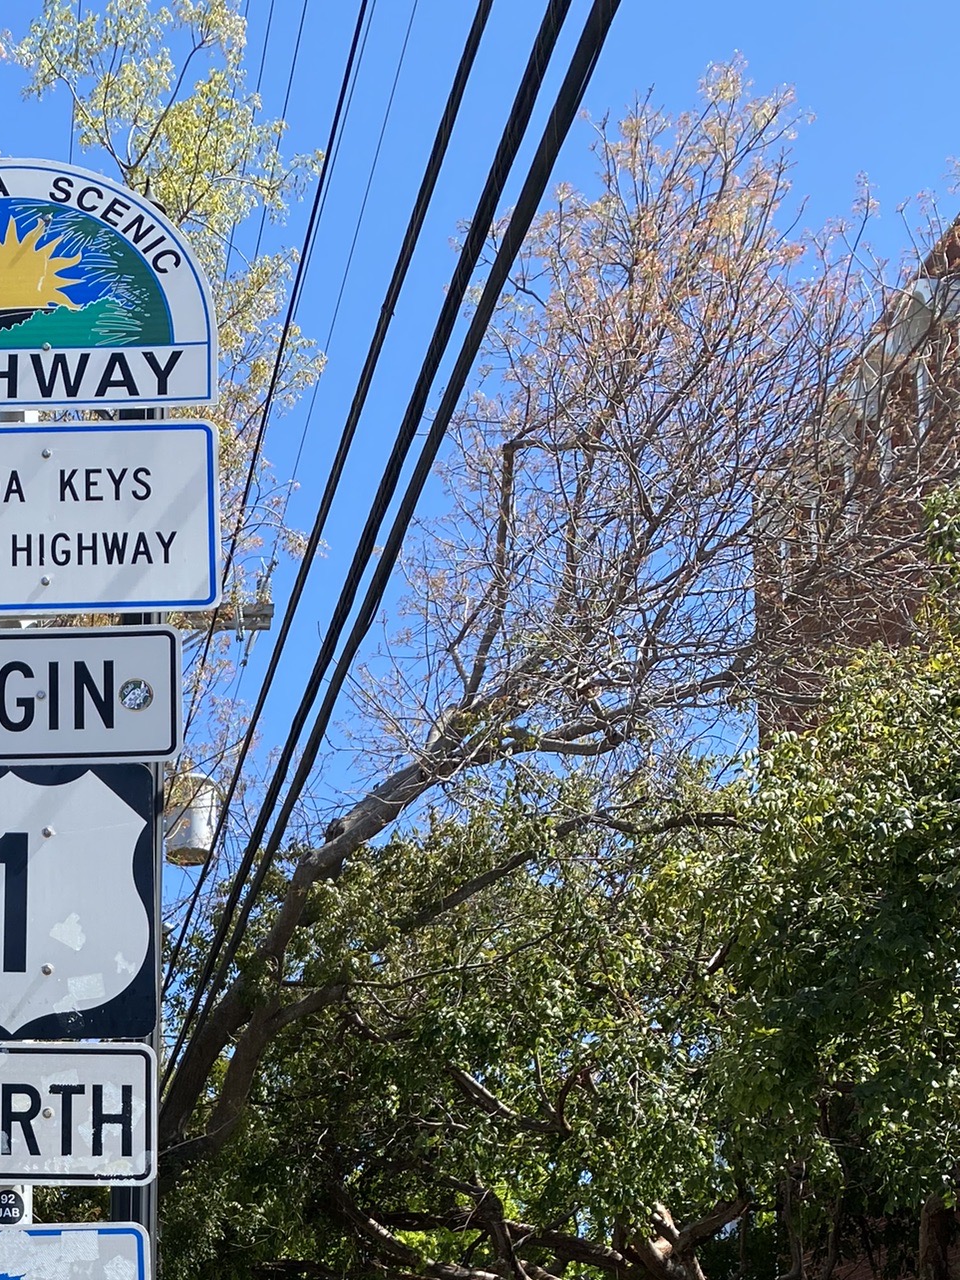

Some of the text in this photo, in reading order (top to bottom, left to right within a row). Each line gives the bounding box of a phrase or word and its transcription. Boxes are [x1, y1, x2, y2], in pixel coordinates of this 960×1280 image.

[49, 175, 183, 276] SCENIC
[59, 466, 153, 502] KEYS
[11, 531, 178, 567] HIGHWAY
[0, 1193, 16, 1204] 92
